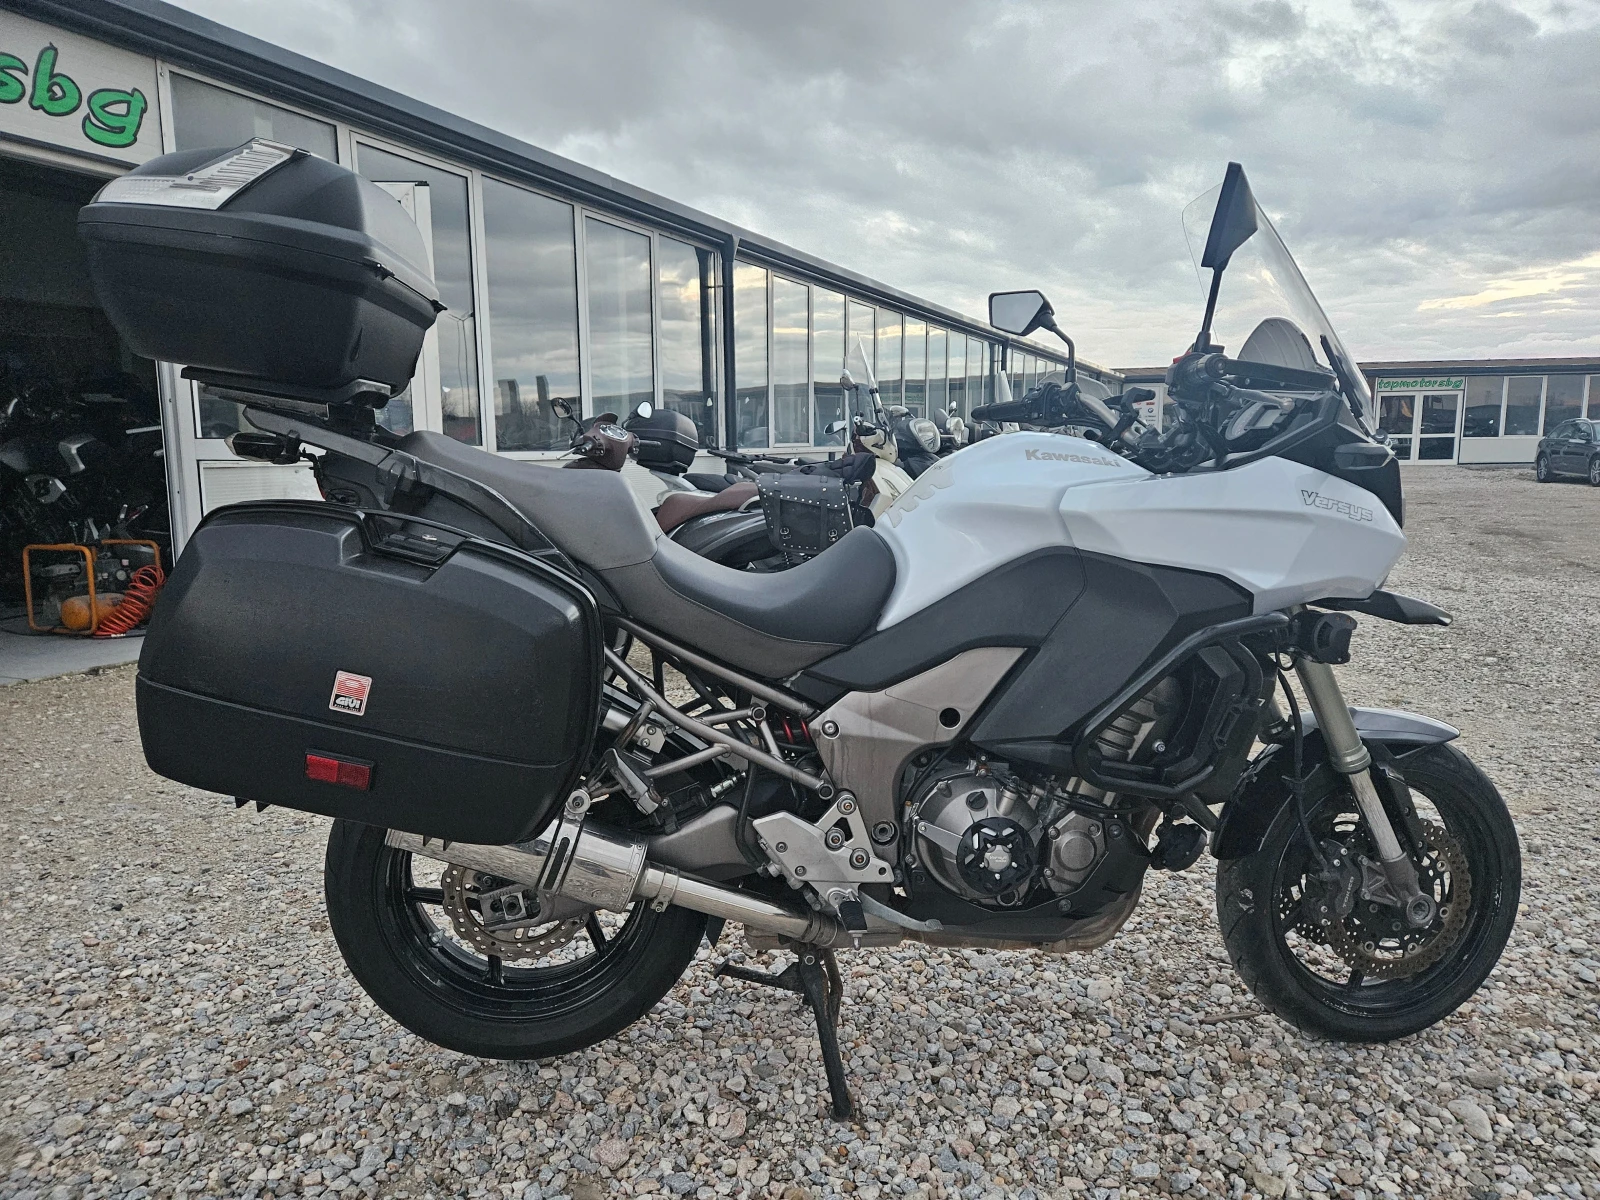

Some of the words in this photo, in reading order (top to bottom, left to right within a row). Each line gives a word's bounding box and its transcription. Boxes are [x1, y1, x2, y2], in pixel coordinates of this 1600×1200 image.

[1378, 377, 1464, 391] topmotorsbg
[1025, 448, 1121, 468] Kawasaki
[1301, 489, 1373, 522] Versys
